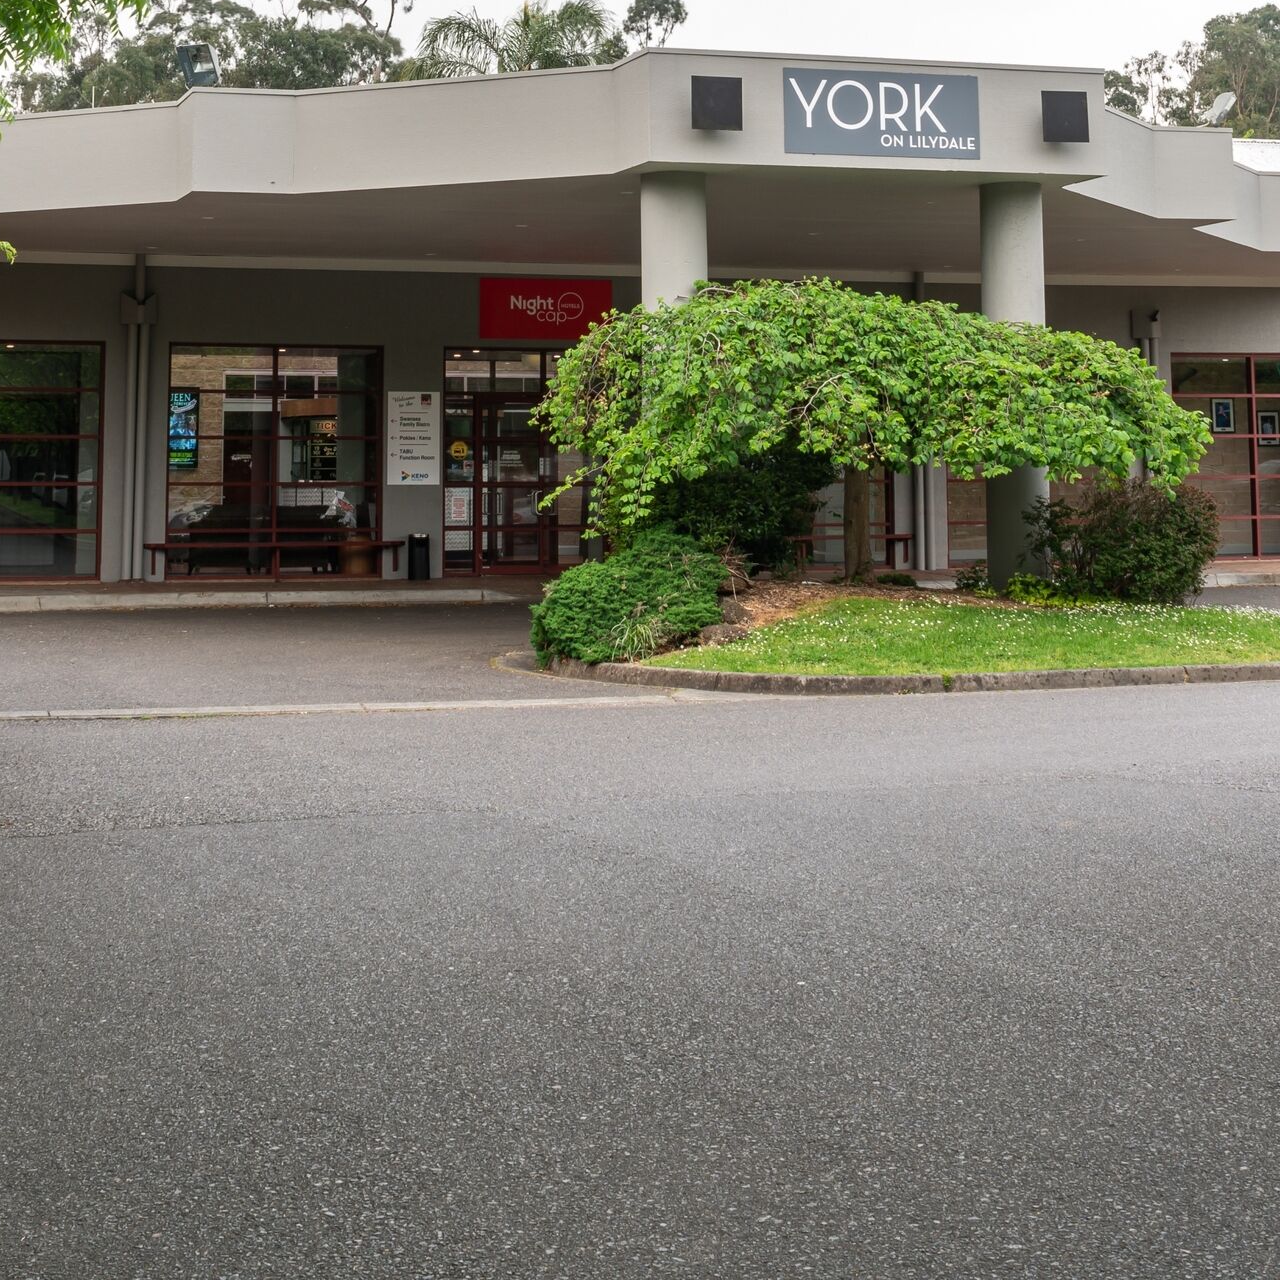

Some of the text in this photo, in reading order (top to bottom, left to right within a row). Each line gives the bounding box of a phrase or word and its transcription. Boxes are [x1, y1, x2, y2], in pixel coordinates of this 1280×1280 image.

[789, 77, 947, 133] YORK
[880, 134, 976, 150] ON LILYDALE
[510, 295, 554, 315] Night
[537, 310, 567, 326] cap
